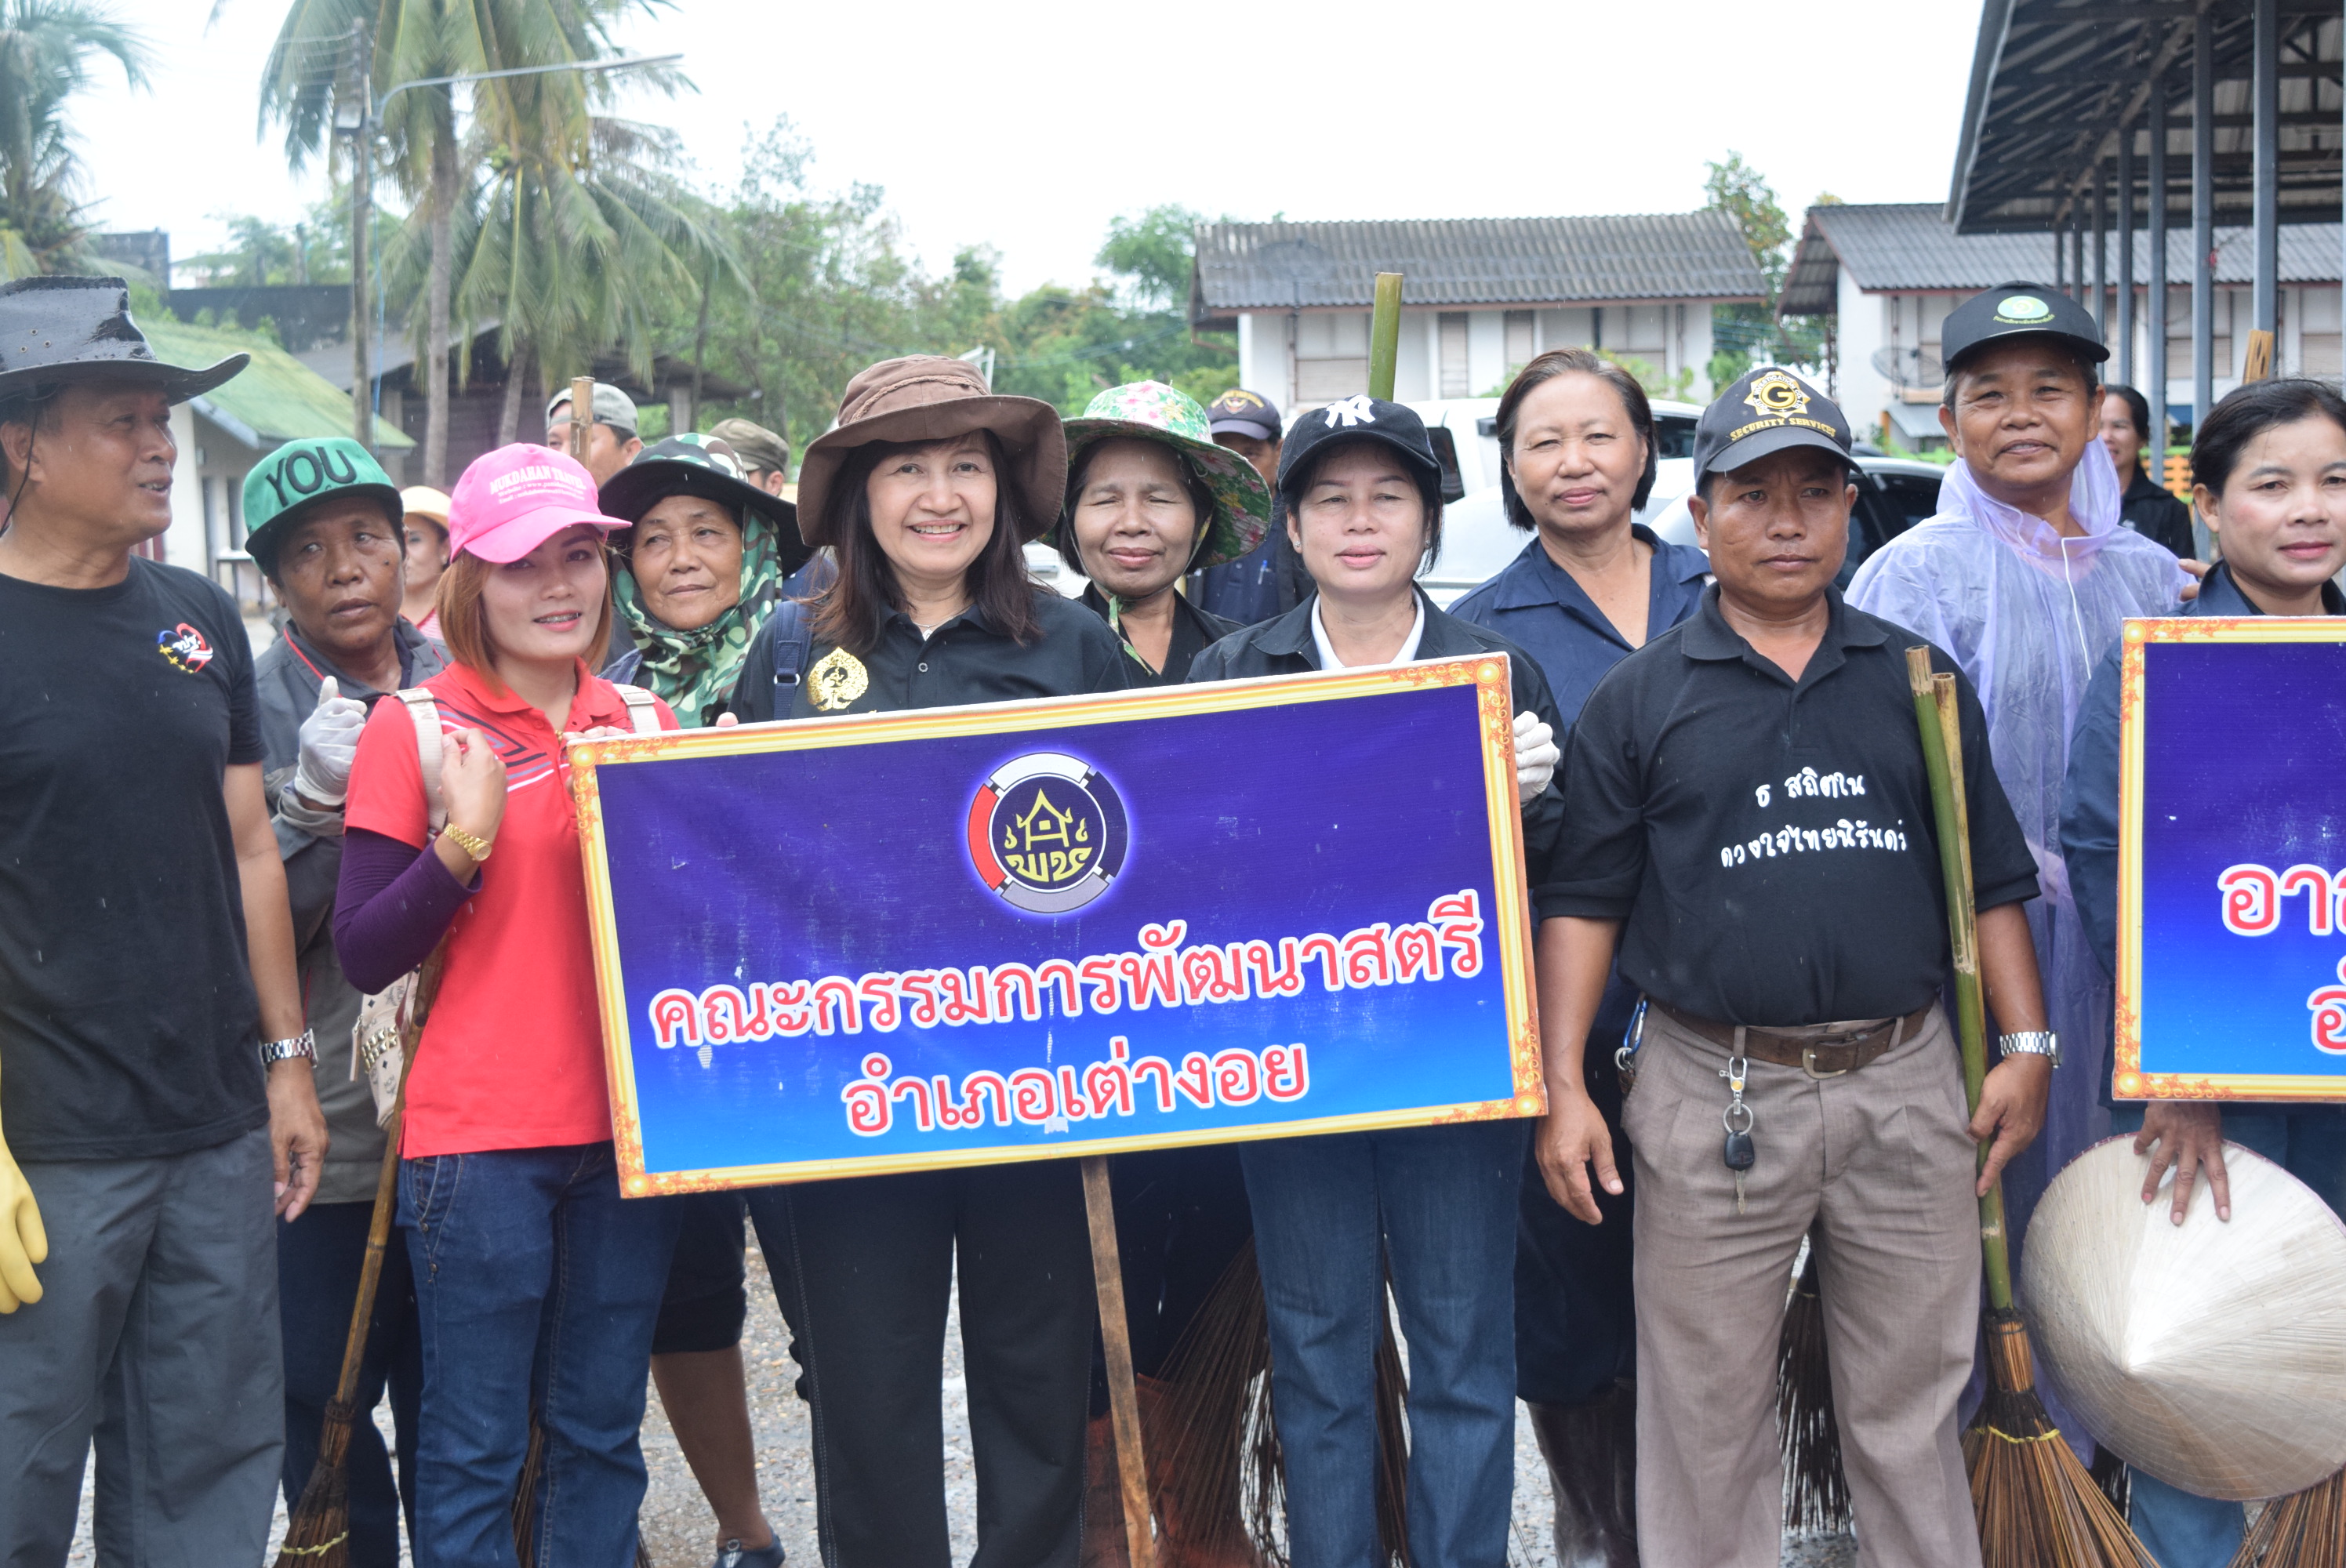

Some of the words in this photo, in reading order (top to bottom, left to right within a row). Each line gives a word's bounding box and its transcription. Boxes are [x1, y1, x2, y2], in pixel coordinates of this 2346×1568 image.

[1761, 381, 1796, 408] G
[1730, 418, 1785, 441] SECURITY
[1789, 418, 1836, 437] SERVICES
[266, 446, 358, 507] YOU
[489, 465, 552, 495] MUKDAHAN
[551, 466, 586, 490] TRAVEL
[1755, 784, 1770, 808] ธ
[1784, 767, 1865, 799] สถิตใน
[2221, 867, 2346, 933] อา
[652, 893, 1480, 1045] คณะกรรมการพัฒนาสตรี
[844, 1037, 1307, 1134] อำเภอเต่างอย
